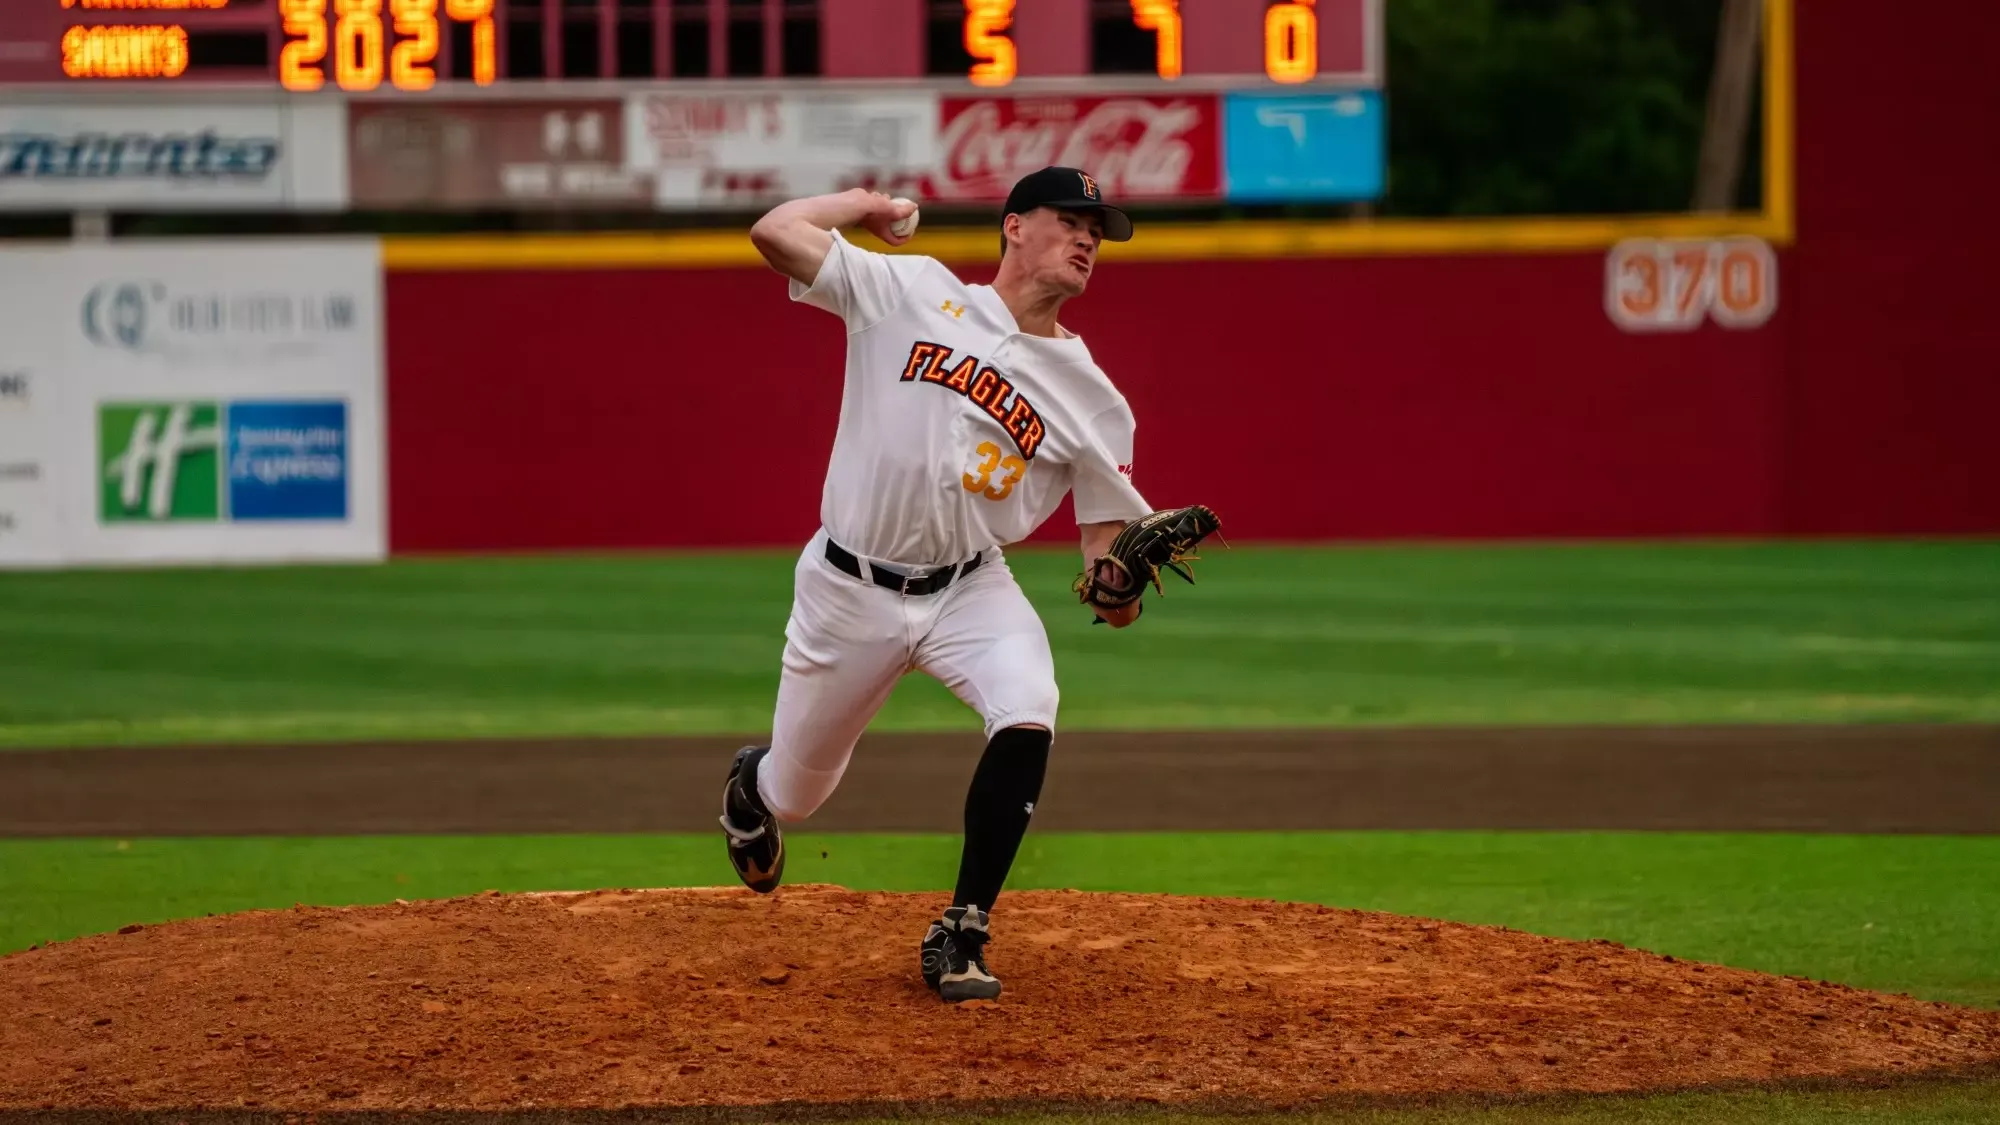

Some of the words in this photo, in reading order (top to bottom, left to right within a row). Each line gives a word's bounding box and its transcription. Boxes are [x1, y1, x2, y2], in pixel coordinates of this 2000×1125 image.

[1264, 3, 1318, 84] 0
[1078, 172, 1099, 200] F
[1609, 241, 1773, 327] 370
[900, 341, 1046, 461] FLAGLER
[962, 440, 1026, 501] 33
